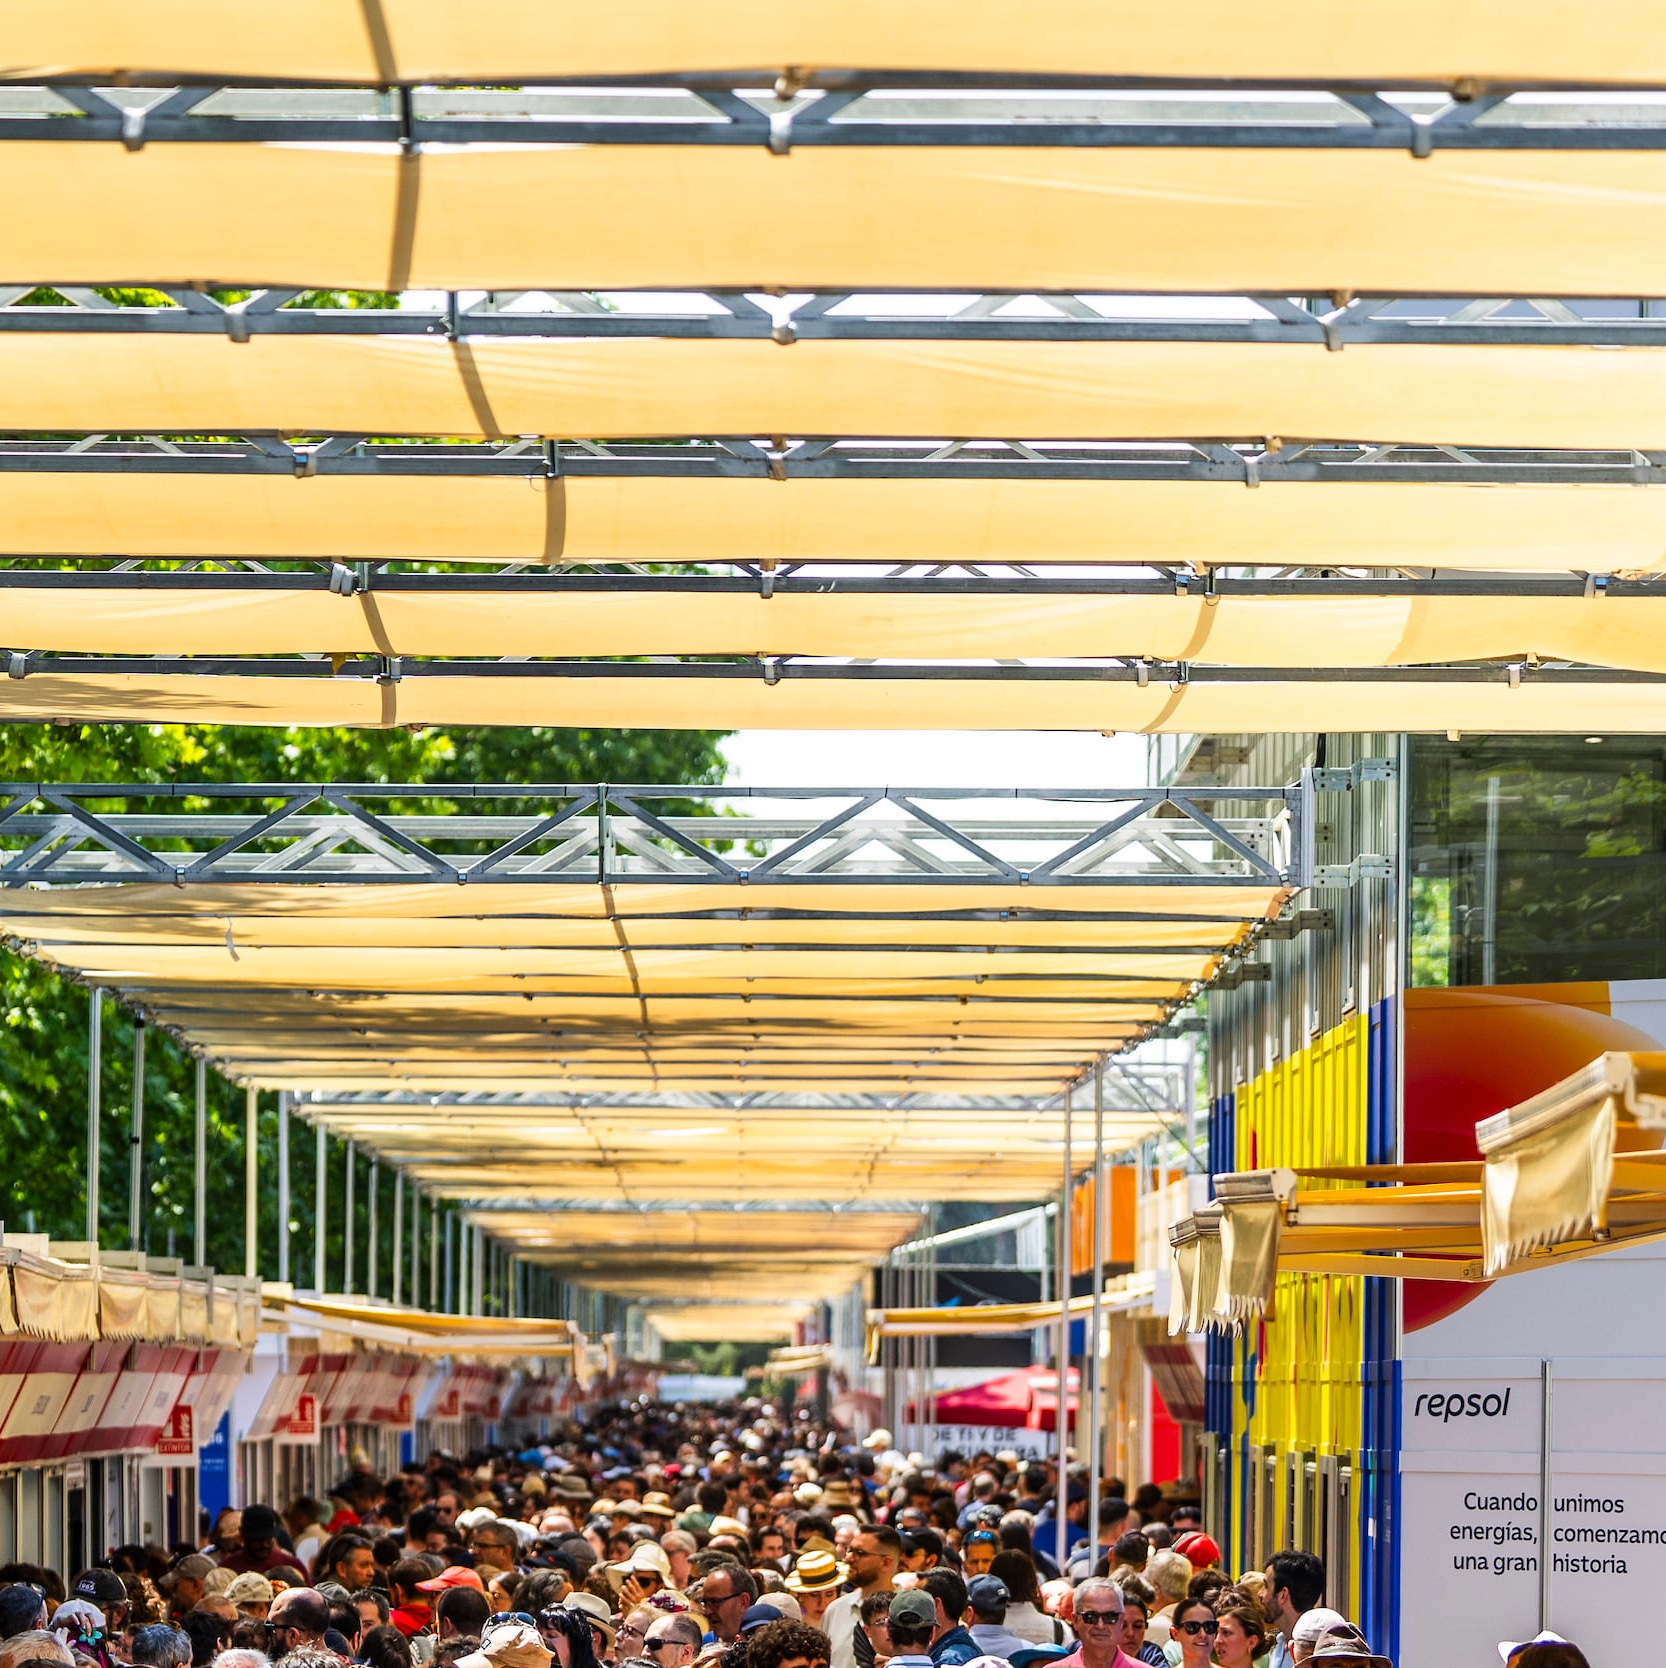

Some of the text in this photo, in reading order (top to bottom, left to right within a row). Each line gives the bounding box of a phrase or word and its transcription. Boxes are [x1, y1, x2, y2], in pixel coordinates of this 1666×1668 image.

[1414, 1387, 1511, 1423] repsol
[993, 1429, 1016, 1441] DE
[1464, 1492, 1624, 1513] Cuando unimos
[1450, 1522, 1537, 1545] energías,
[1453, 1554, 1627, 1575] una gran historia
